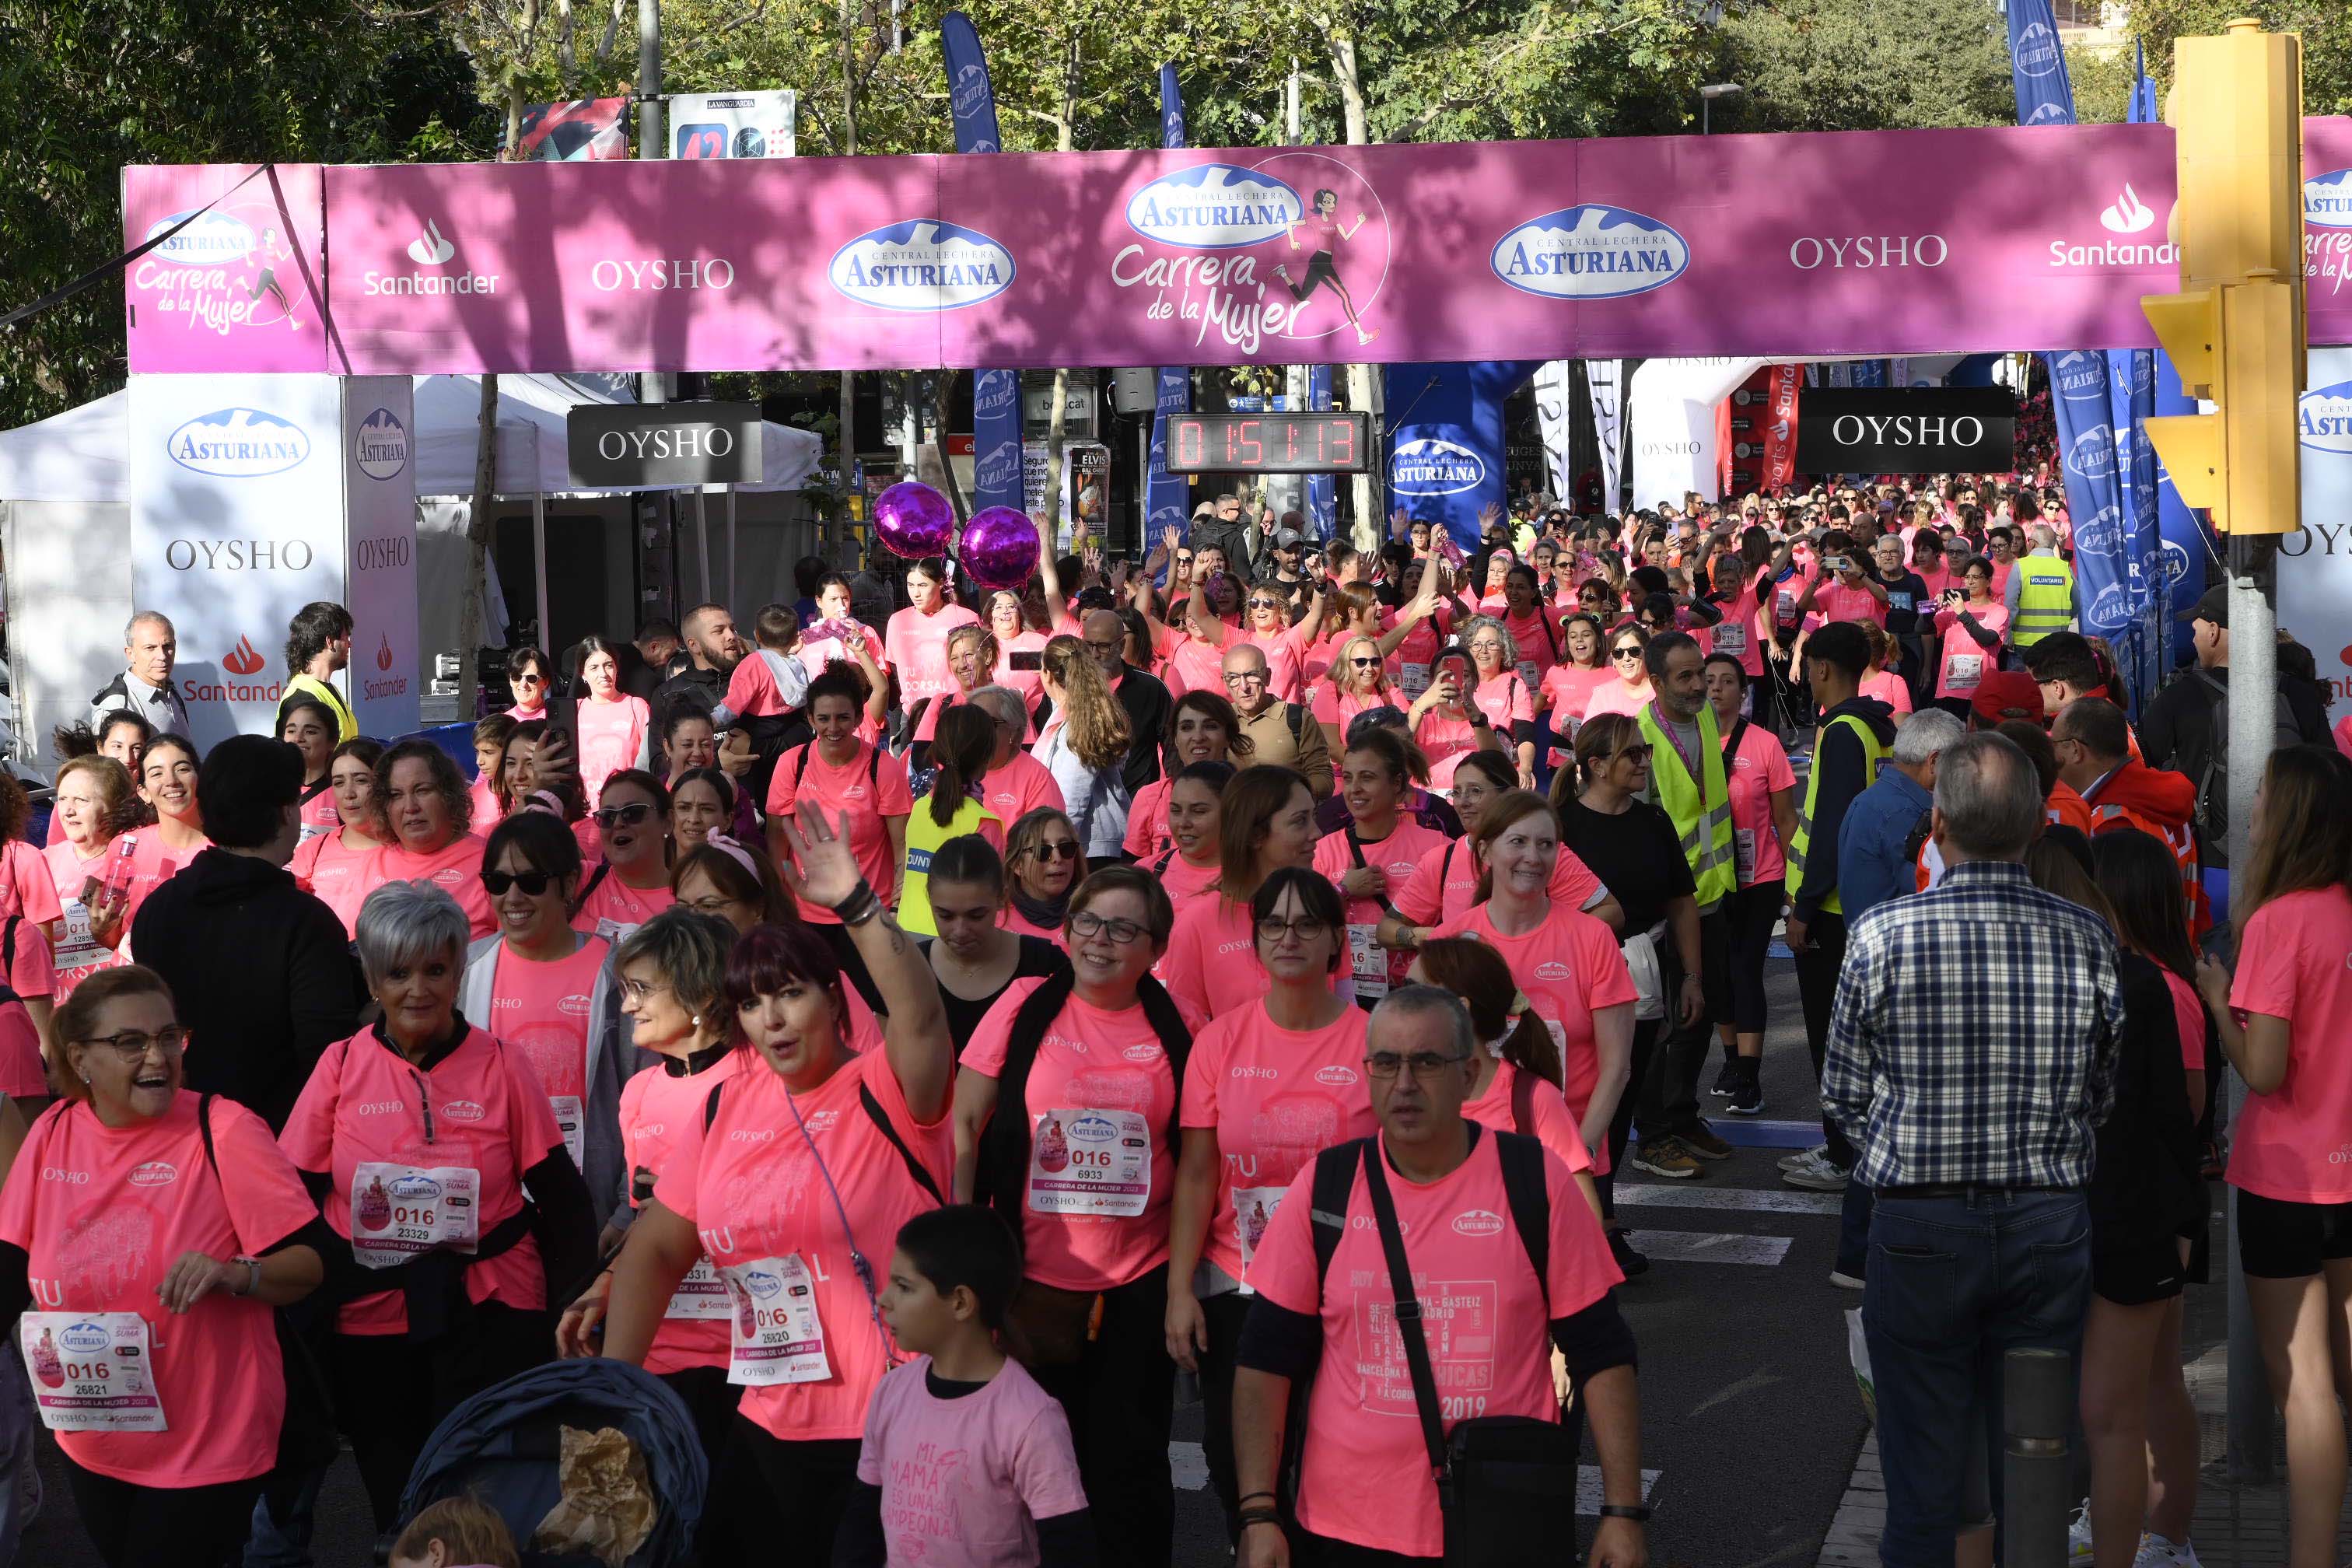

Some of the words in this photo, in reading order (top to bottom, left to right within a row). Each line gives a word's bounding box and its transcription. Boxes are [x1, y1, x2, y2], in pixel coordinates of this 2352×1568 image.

[1227, 192, 1284, 201] LECHERA
[1139, 197, 1289, 227] ASTURIANA
[1538, 236, 1598, 248] CENTRAL
[1605, 234, 1668, 246] LECHERA
[872, 250, 929, 260] CENTRAL
[936, 250, 1003, 259] LECHERA
[1506, 240, 1675, 276] ASTURIANA
[1790, 234, 1948, 269] OYSHO
[851, 254, 1010, 287] ASTURIANA
[1111, 243, 1258, 287] Carrera
[2322, 254, 2336, 277] la
[135, 261, 226, 291] Carrera
[364, 271, 499, 296] Santander
[592, 259, 735, 291] OYSHO
[158, 291, 174, 311] de
[178, 289, 191, 312] la
[188, 288, 261, 335] Mujer
[1147, 290, 1174, 320] de
[1181, 288, 1199, 320] la
[1195, 280, 1311, 355] Mujer
[1832, 415, 1983, 446] OYSHO
[179, 434, 299, 460] ASTURIANA
[360, 436, 404, 463] ASTURIANA
[599, 428, 733, 460] OYSHO
[1179, 422, 1355, 465] 01:51:13
[1642, 441, 1701, 455] OYSHO
[1082, 455, 1106, 465] ELVIS
[1024, 469, 1037, 481] que
[1390, 465, 1478, 484] ASTURIANA
[1026, 499, 1040, 508] este
[166, 539, 313, 570] OYSHO
[357, 536, 409, 571] OYSHO
[364, 674, 408, 701] Santander
[905, 680, 948, 691] DORSAL
[1231, 1066, 1278, 1080] OYSHO
[1318, 1073, 1355, 1082] ASTURIANA
[359, 1100, 404, 1115] OYSHO
[1071, 1125, 1114, 1138] ASTURIANA
[1122, 1125, 1144, 1133] SUMA
[1072, 1149, 1111, 1167] 016
[1077, 1169, 1103, 1181] 6933
[392, 1183, 437, 1196] ASTURIANA
[1040, 1195, 1076, 1206] OYSHO
[1104, 1199, 1141, 1209] Santander
[394, 1206, 435, 1226] 016
[1455, 1219, 1500, 1231] ASTURIANA
[397, 1227, 429, 1240] 23329
[700, 1226, 735, 1256] TU
[30, 1277, 62, 1307] TU
[701, 1284, 725, 1293] MUJER
[1442, 1296, 1482, 1307] GASTEIZ
[757, 1307, 788, 1328] 016
[63, 1334, 106, 1346] ASTURIANA
[115, 1329, 139, 1338] SUMA
[762, 1330, 789, 1345] 26820
[67, 1362, 110, 1381] 016
[742, 1365, 776, 1377] OYSHO
[74, 1384, 107, 1395] 26821
[1441, 1395, 1486, 1420] 2019
[51, 1413, 87, 1423] OYSHO
[114, 1415, 155, 1423] Santander
